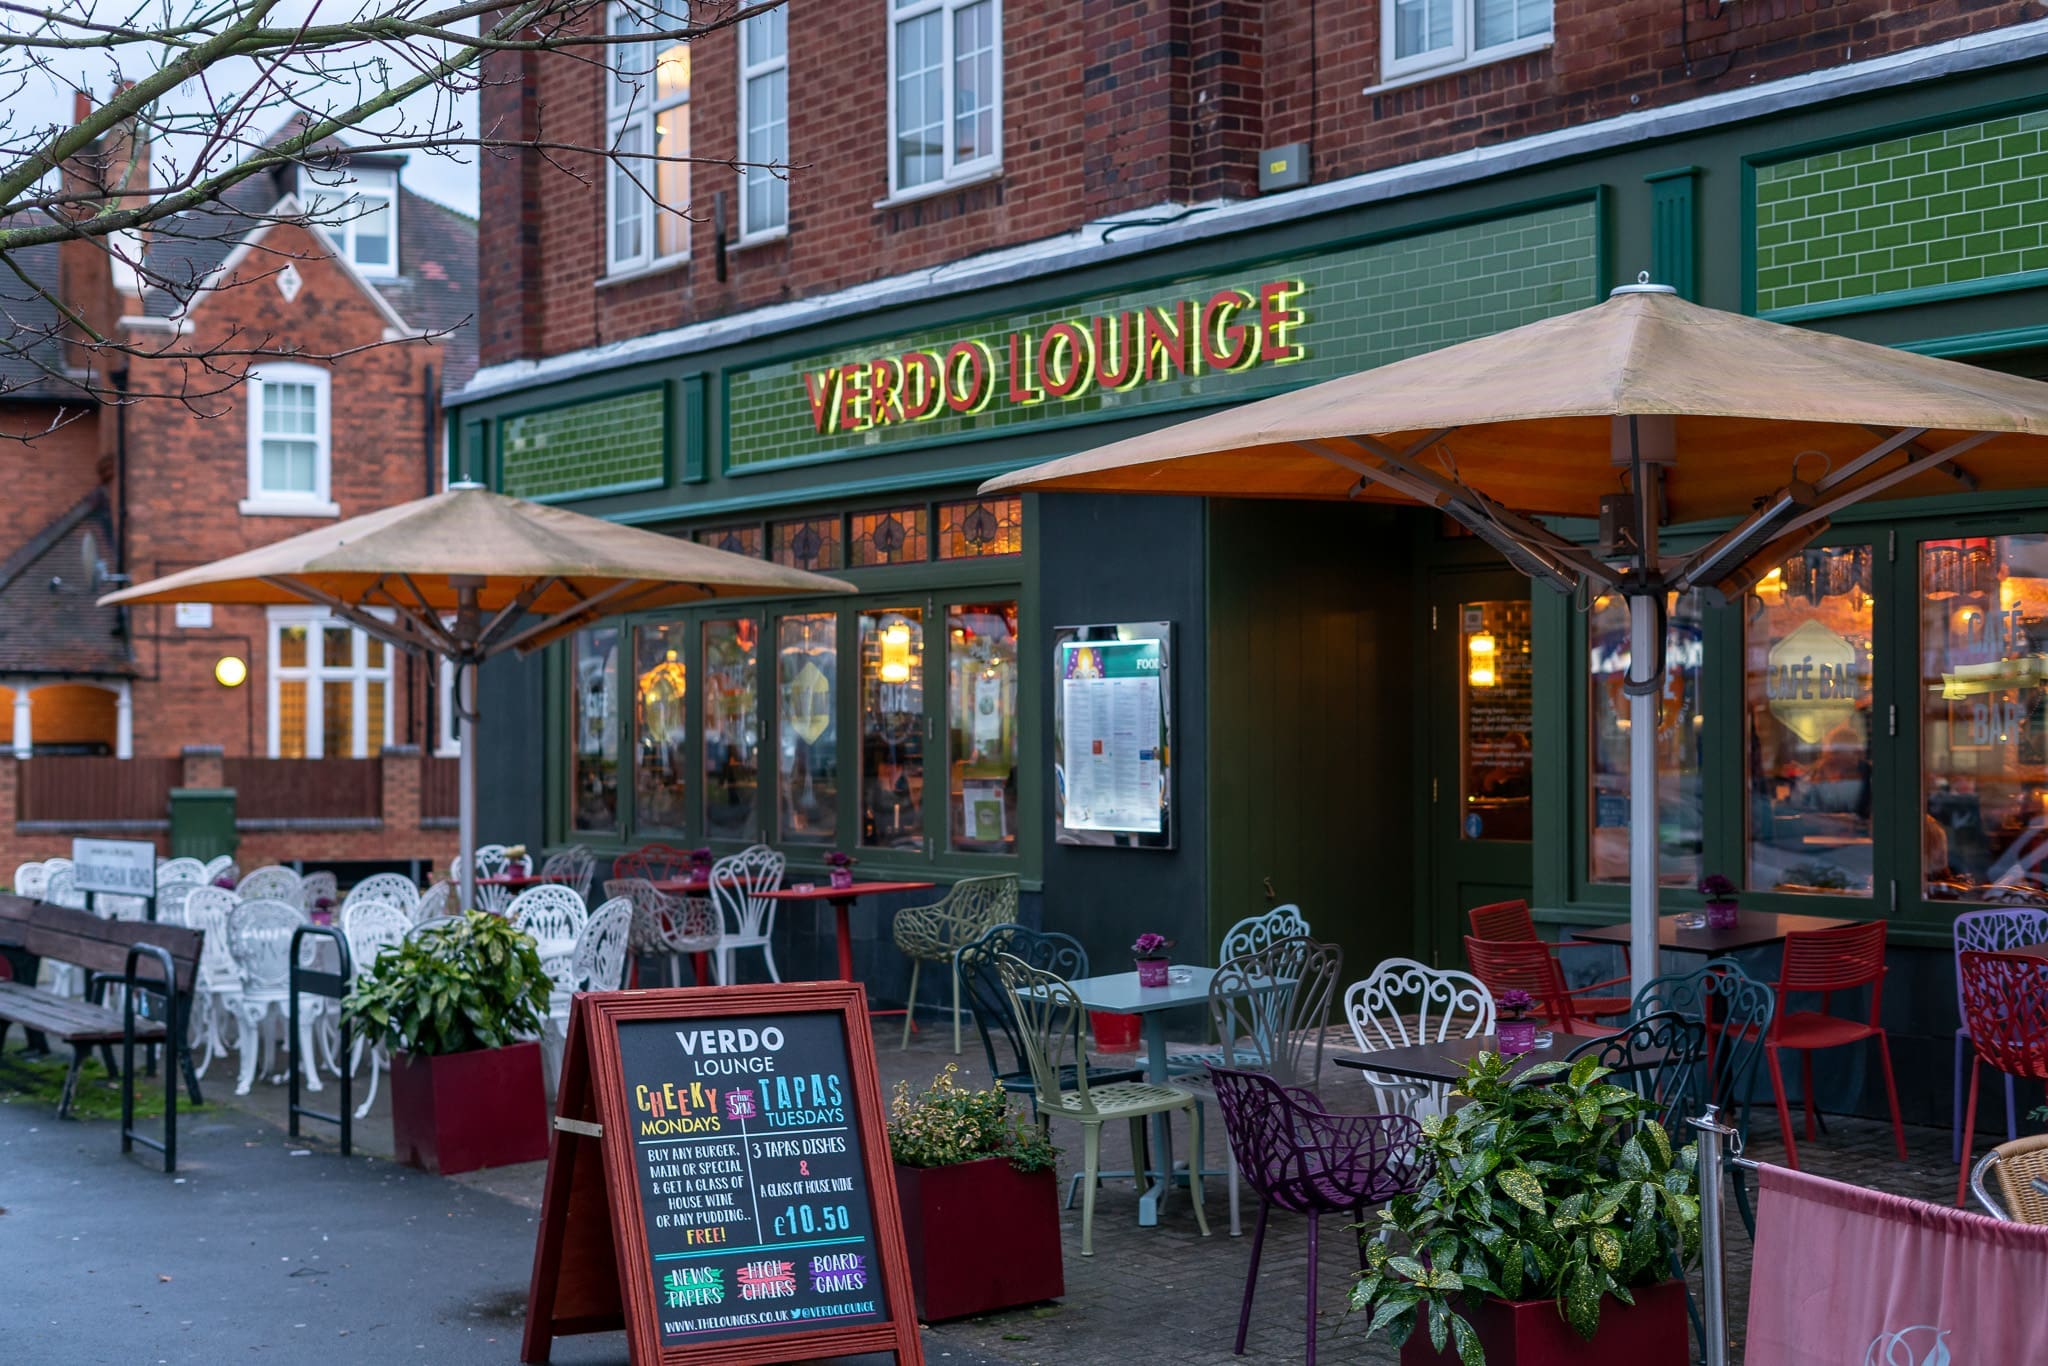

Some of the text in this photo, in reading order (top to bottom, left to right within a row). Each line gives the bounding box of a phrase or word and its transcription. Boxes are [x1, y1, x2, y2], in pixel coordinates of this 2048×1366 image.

[804, 281, 1303, 433] VERDO LOUNGE
[1766, 656, 1813, 700] CAFÉ
[675, 1026, 785, 1055] VERDO
[694, 1056, 775, 1076] LOUNGE
[635, 1082, 718, 1118] CHEEKY
[758, 1073, 842, 1111] TAPAS
[641, 1116, 721, 1136] MONDAYS
[765, 1107, 845, 1127] TUESDAYS
[647, 1148, 669, 1162] BUY
[672, 1146, 693, 1160] ANY
[752, 1136, 846, 1159] 3 TAPAS DISHES
[649, 1159, 744, 1179] MAIN OR SPECIAL
[799, 1160, 810, 1177] &
[653, 1175, 744, 1195] & GET A GLASS OF
[760, 1176, 854, 1198] A GLASS OF HOUSE WINE
[668, 1192, 735, 1211] HOUSE WINE
[656, 1214, 671, 1228] OR
[673, 1212, 694, 1227] ANY
[774, 1204, 850, 1236] £10.50
[686, 1226, 727, 1245] FREE!
[747, 1260, 782, 1280] HIGH
[813, 1252, 858, 1273] BOARD
[671, 1266, 714, 1287] NEWS
[816, 1273, 864, 1294] GAMES
[669, 1287, 722, 1309] PAPERS
[742, 1280, 794, 1301] CHAIRS
[664, 1300, 876, 1333] WWW.THELOUNGES.CO.UK @VERDOLOUNGE
